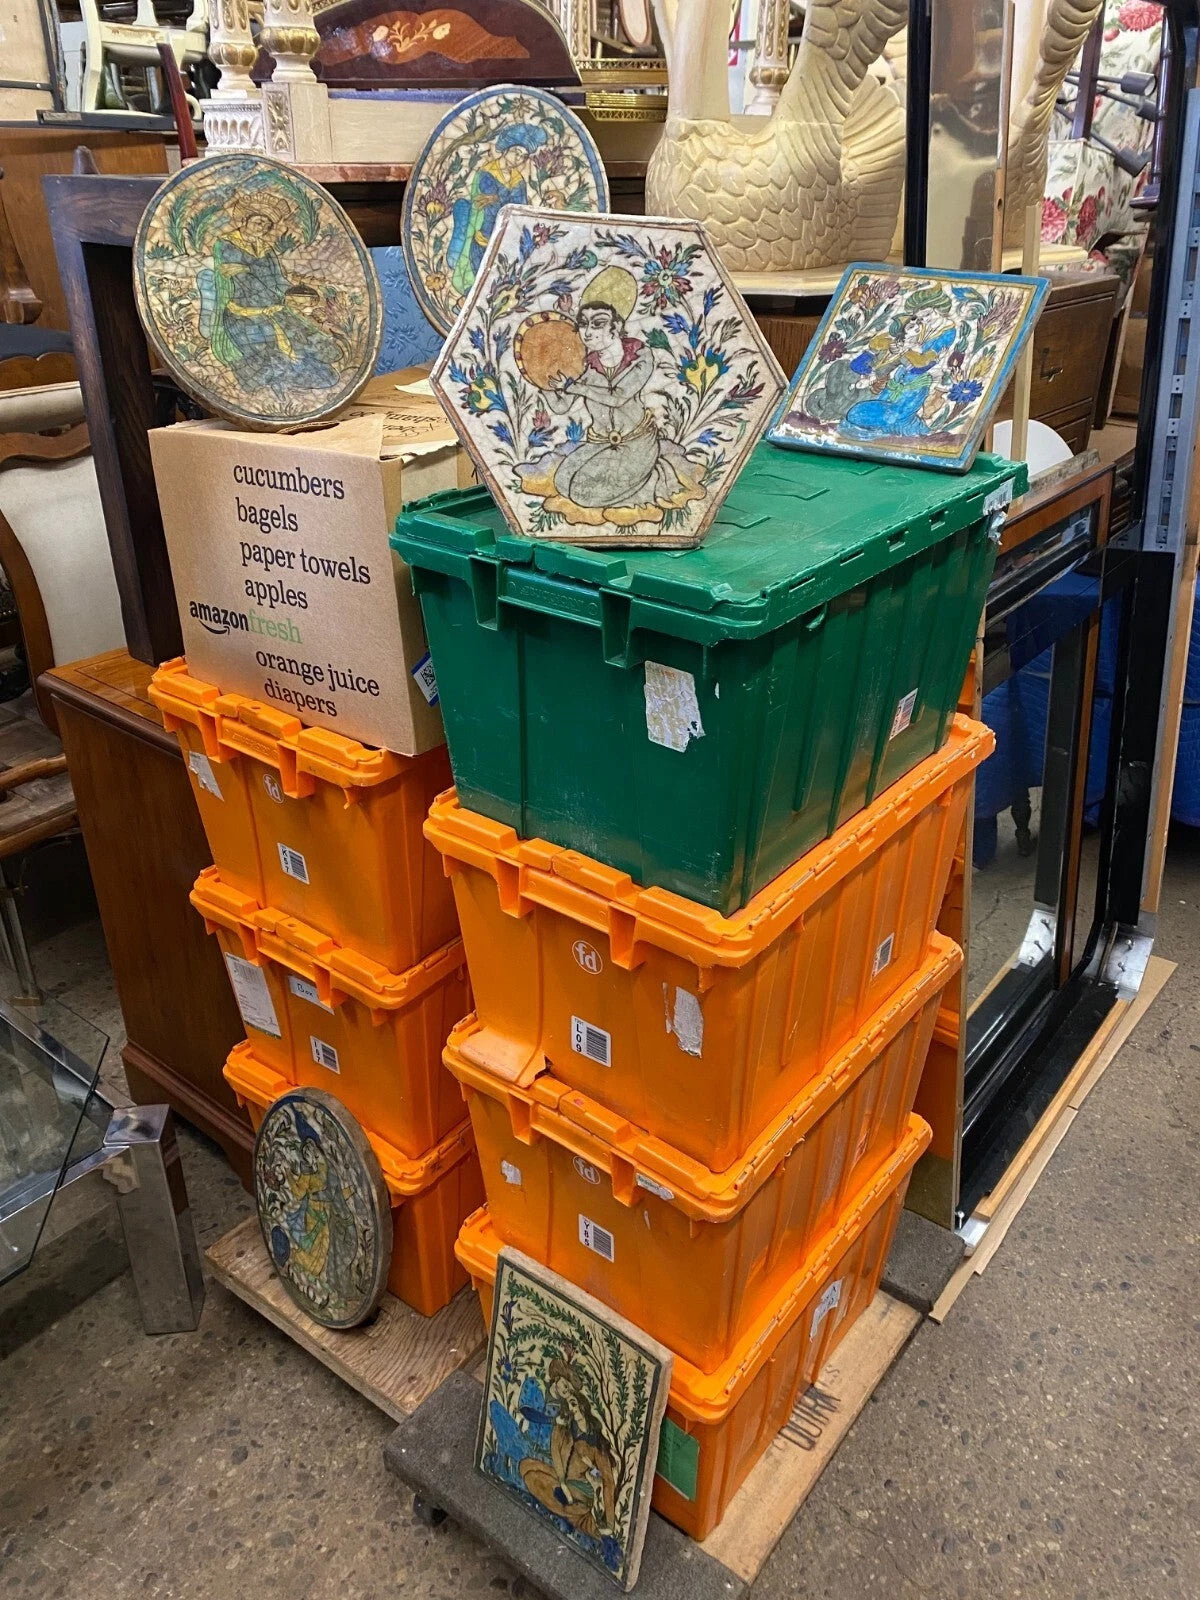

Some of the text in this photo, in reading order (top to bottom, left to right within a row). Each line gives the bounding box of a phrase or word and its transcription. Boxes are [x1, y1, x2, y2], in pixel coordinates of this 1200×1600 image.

[233, 464, 345, 500] cucumbers
[235, 497, 299, 534] bagels
[240, 540, 371, 585] paper towels
[245, 578, 309, 610] apples
[256, 650, 380, 697] orange juice
[264, 678, 338, 717] diapers
[575, 942, 598, 972] fd
